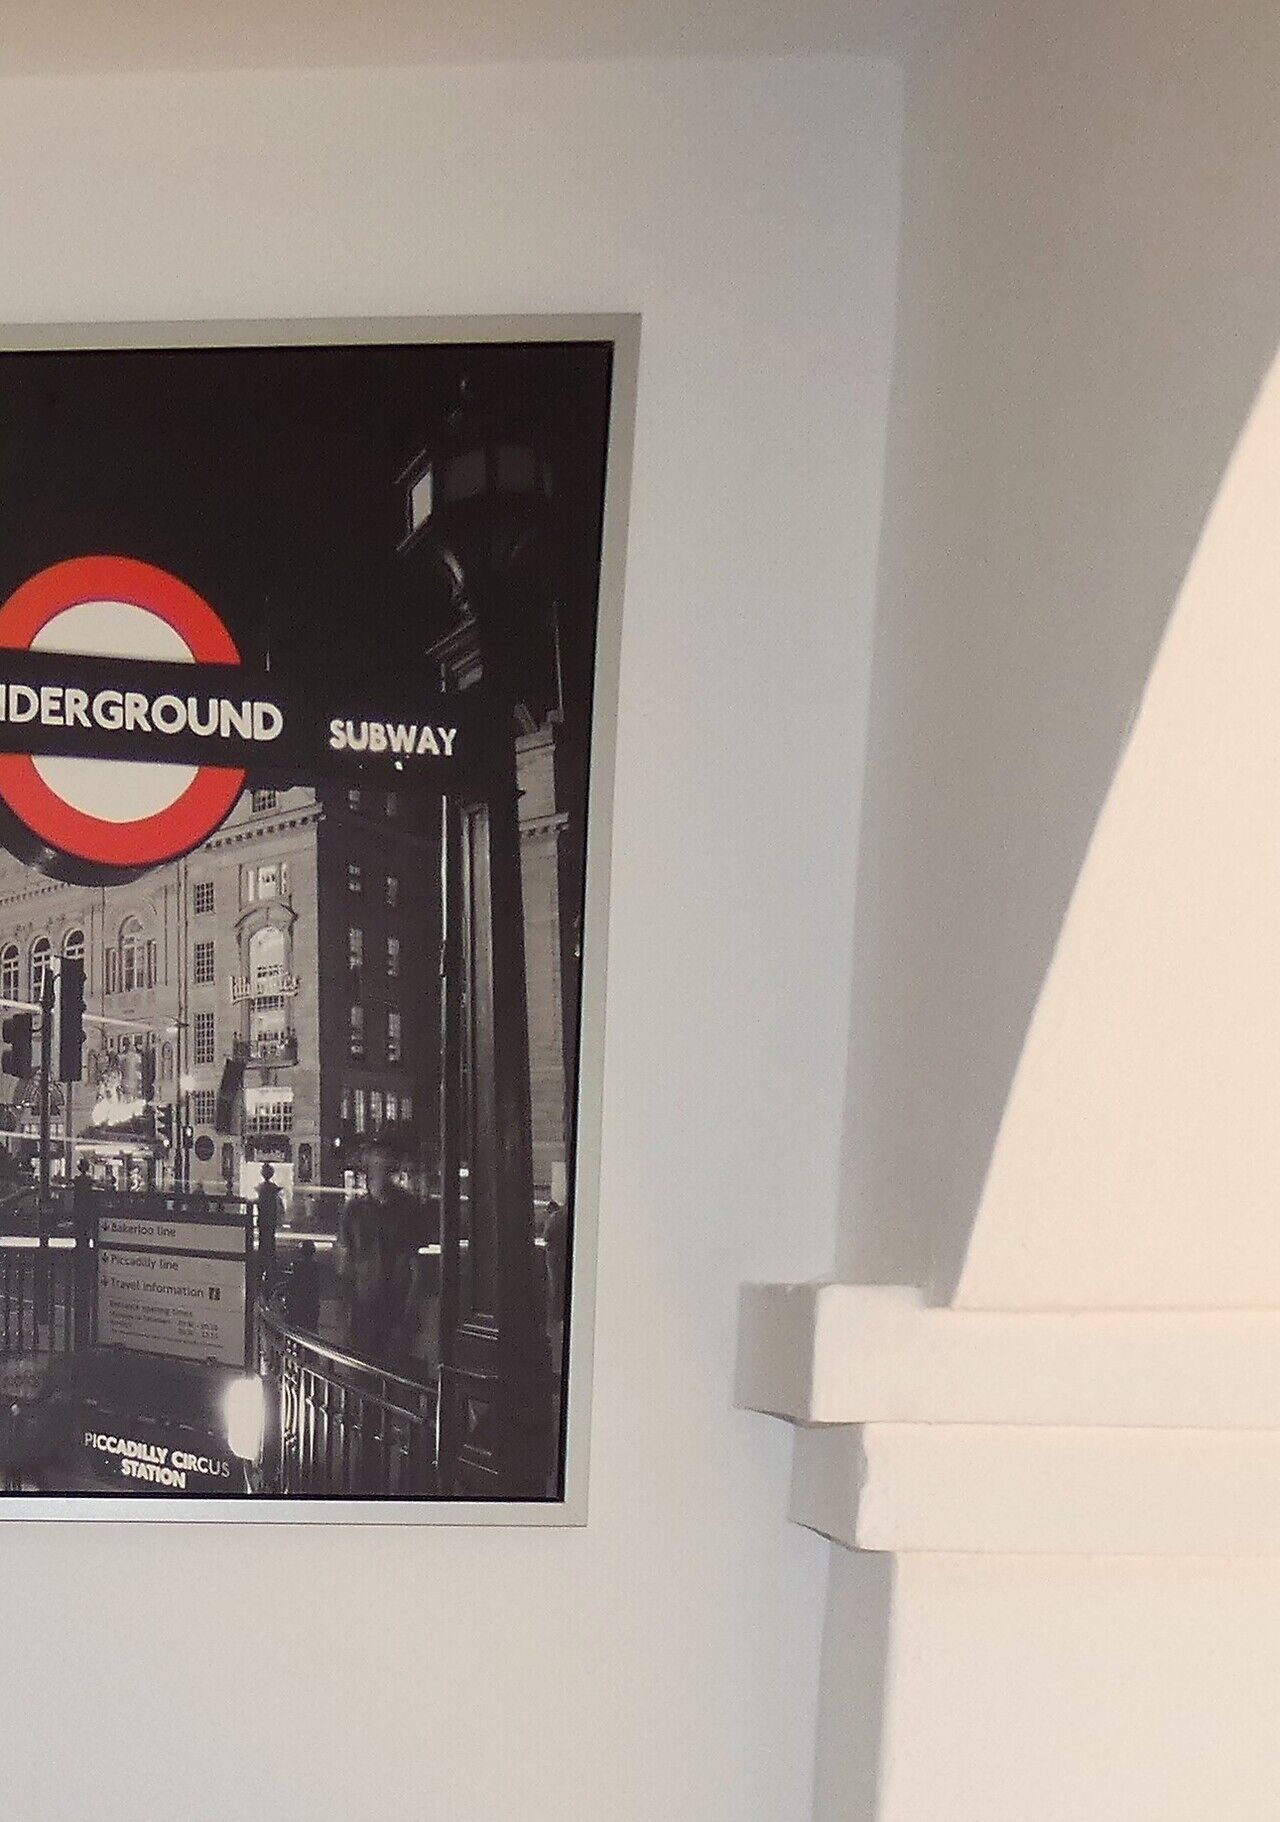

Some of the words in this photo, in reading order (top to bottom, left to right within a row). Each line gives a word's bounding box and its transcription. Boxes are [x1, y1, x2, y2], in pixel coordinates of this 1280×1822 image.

[329, 718, 457, 756] SUBWAY
[157, 1227, 177, 1237] line
[159, 1260, 179, 1271] line
[111, 1277, 140, 1290] Travel
[143, 1281, 204, 1298] information
[84, 1432, 169, 1464] PICCADILLY
[171, 1451, 230, 1477] CIRCUS
[121, 1458, 186, 1489] STATION
